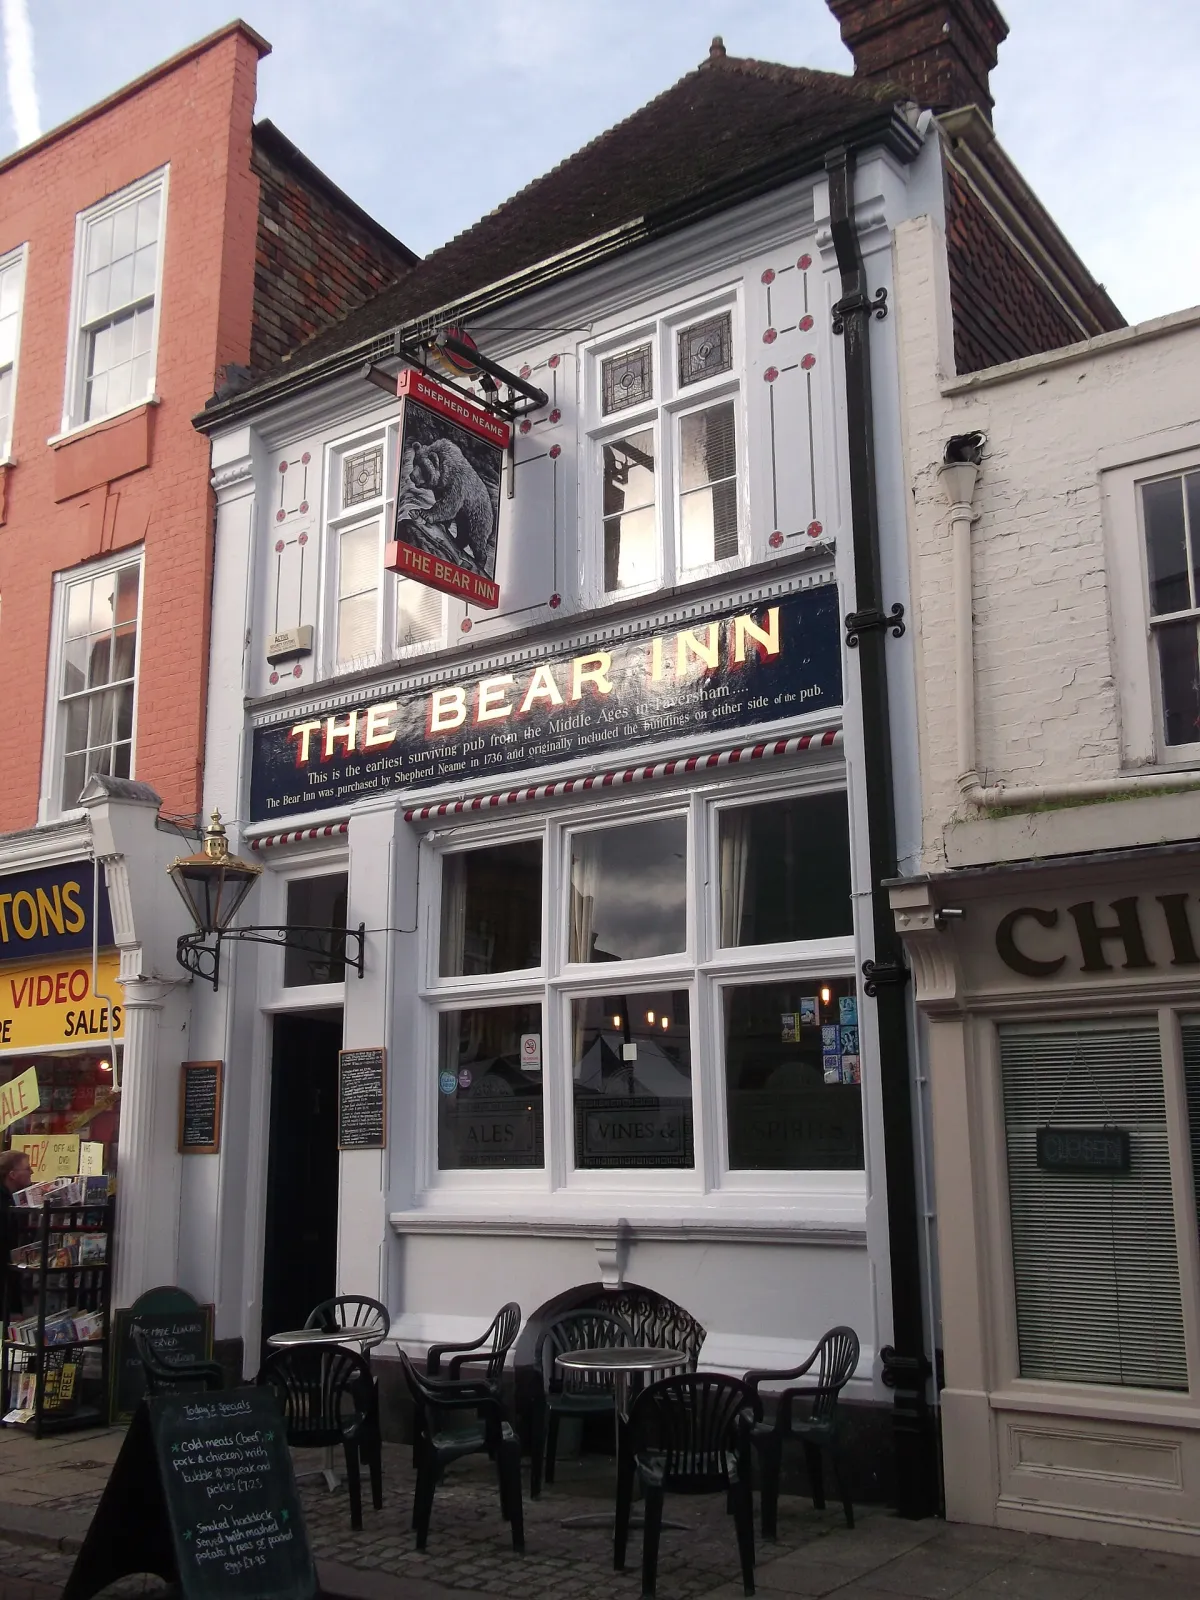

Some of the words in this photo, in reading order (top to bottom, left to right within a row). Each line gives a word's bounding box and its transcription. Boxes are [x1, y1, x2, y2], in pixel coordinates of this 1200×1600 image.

[417, 383, 470, 418] SHEPHERD
[472, 413, 503, 438] NEAME
[403, 548, 431, 574] THE
[434, 562, 470, 591] BEAR
[474, 579, 495, 600] INN
[289, 701, 398, 765] THE
[427, 651, 613, 734] BEAR
[650, 605, 781, 682] INN
[266, 797, 280, 809] The
[283, 794, 301, 805] Bear
[303, 791, 316, 802] Inn
[318, 788, 334, 798] was
[337, 777, 378, 797] purchased
[381, 776, 391, 787] by
[394, 765, 434, 784] Shepherd
[438, 760, 466, 775] Neame
[470, 756, 479, 768] in
[484, 752, 502, 765] 1736
[506, 747, 524, 760] and
[529, 737, 573, 755] originally
[578, 727, 619, 746] included
[623, 723, 638, 736] the
[643, 712, 690, 731] buildings
[695, 710, 707, 720] on
[712, 702, 742, 718] either
[747, 696, 769, 710] side
[774, 693, 782, 705] of
[784, 692, 797, 702] the
[800, 684, 824, 703] pub.
[308, 771, 328, 785] This
[332, 768, 340, 780] is
[345, 765, 360, 778] the
[366, 756, 402, 773] earliest
[408, 745, 457, 764] surviving
[463, 737, 485, 755] pub
[490, 732, 517, 747] from
[524, 727, 541, 740] the
[549, 714, 591, 734] Middle
[596, 707, 629, 724] Ages
[636, 703, 648, 715] in
[0, 881, 85, 942] TONS
[995, 892, 1200, 977] CHI
[10, 969, 89, 1008] VIDEO
[0, 1019, 13, 1043] E
[64, 1006, 122, 1037] SALES
[0, 1080, 28, 1125] ALE
[468, 1124, 515, 1143] ALES
[660, 1121, 677, 1139] &
[61, 1371, 73, 1398] FREE
[183, 1403, 215, 1418] Today's
[172, 1456, 196, 1471] pork
[205, 1448, 243, 1463] chicken)
[245, 1446, 268, 1458] with
[181, 1438, 204, 1453] Cold
[205, 1436, 234, 1448] meats
[181, 1470, 213, 1483] bubble
[223, 1463, 255, 1479] squeak
[257, 1461, 271, 1471] and
[206, 1482, 236, 1499] pickles
[196, 1516, 230, 1534] Smoked
[231, 1509, 273, 1527] haddock
[225, 1529, 245, 1543] with
[245, 1518, 279, 1538] mashed
[195, 1548, 227, 1566] potato
[236, 1541, 254, 1556] peas
[267, 1528, 293, 1550] poached
[224, 1561, 243, 1575] eggs
